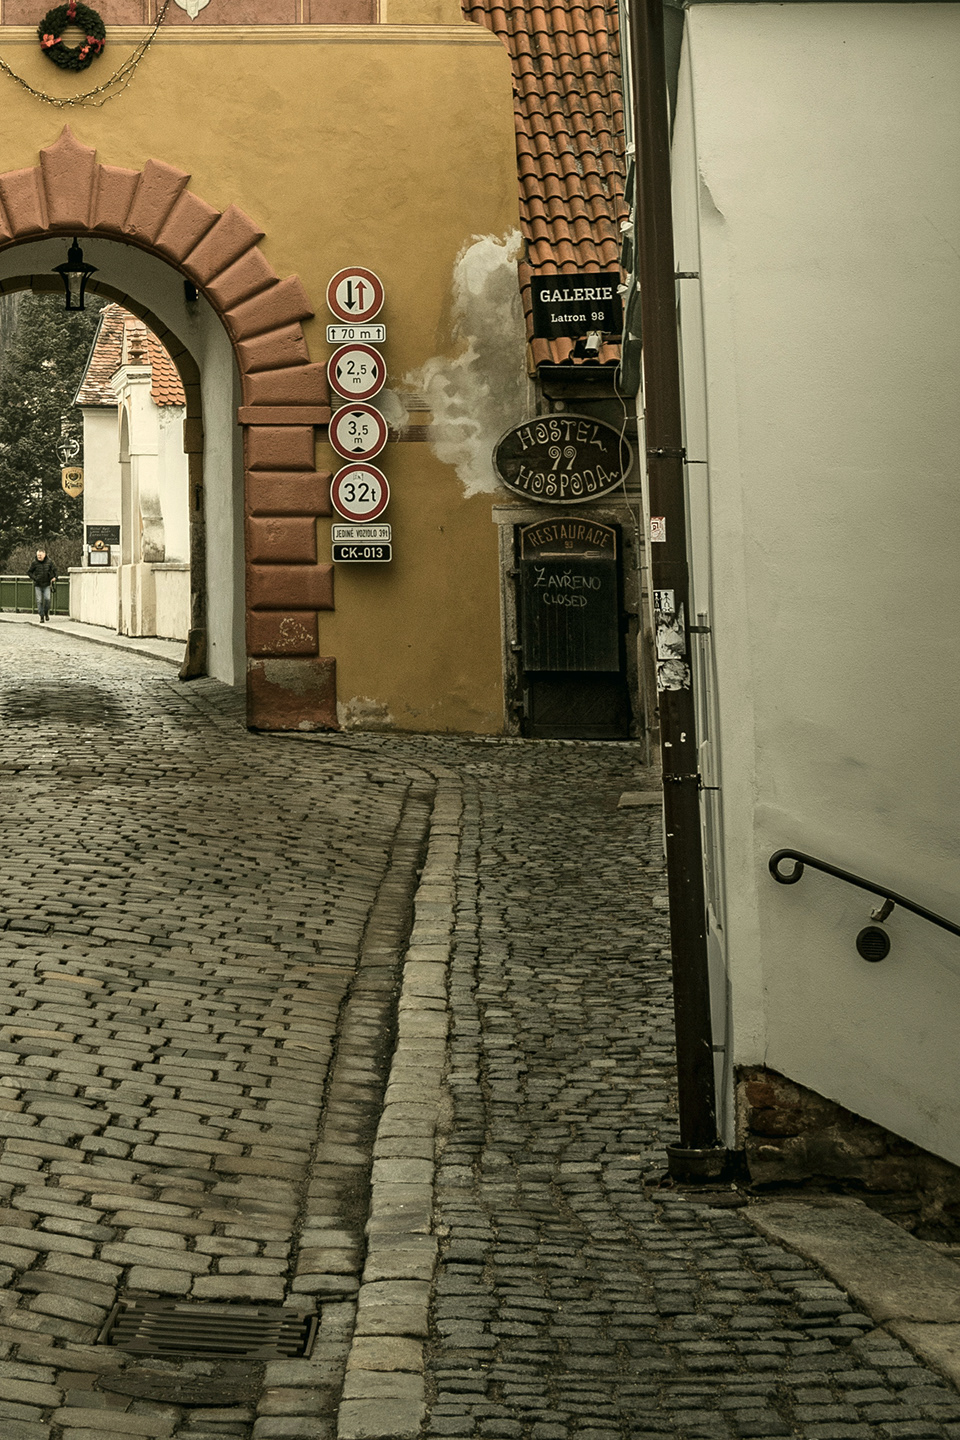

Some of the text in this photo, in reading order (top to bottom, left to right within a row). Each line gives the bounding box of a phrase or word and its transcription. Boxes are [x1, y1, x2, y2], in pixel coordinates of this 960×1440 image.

[540, 287, 613, 302] GALERIE
[551, 312, 605, 322] Latron 98
[341, 329, 371, 339] 70 m
[346, 360, 367, 376] 2,5
[348, 421, 369, 436] 3,5
[516, 420, 607, 452] HOSTEL
[548, 445, 577, 470] 99
[514, 465, 619, 496] HOSPODA
[336, 528, 354, 538] JEDINÉ
[356, 529, 377, 538] VOZIDLO
[528, 524, 610, 548] RESTAURACE
[341, 547, 383, 558] CK-013
[534, 565, 601, 590] ZAVŘENO
[543, 592, 587, 607] CLOSED
